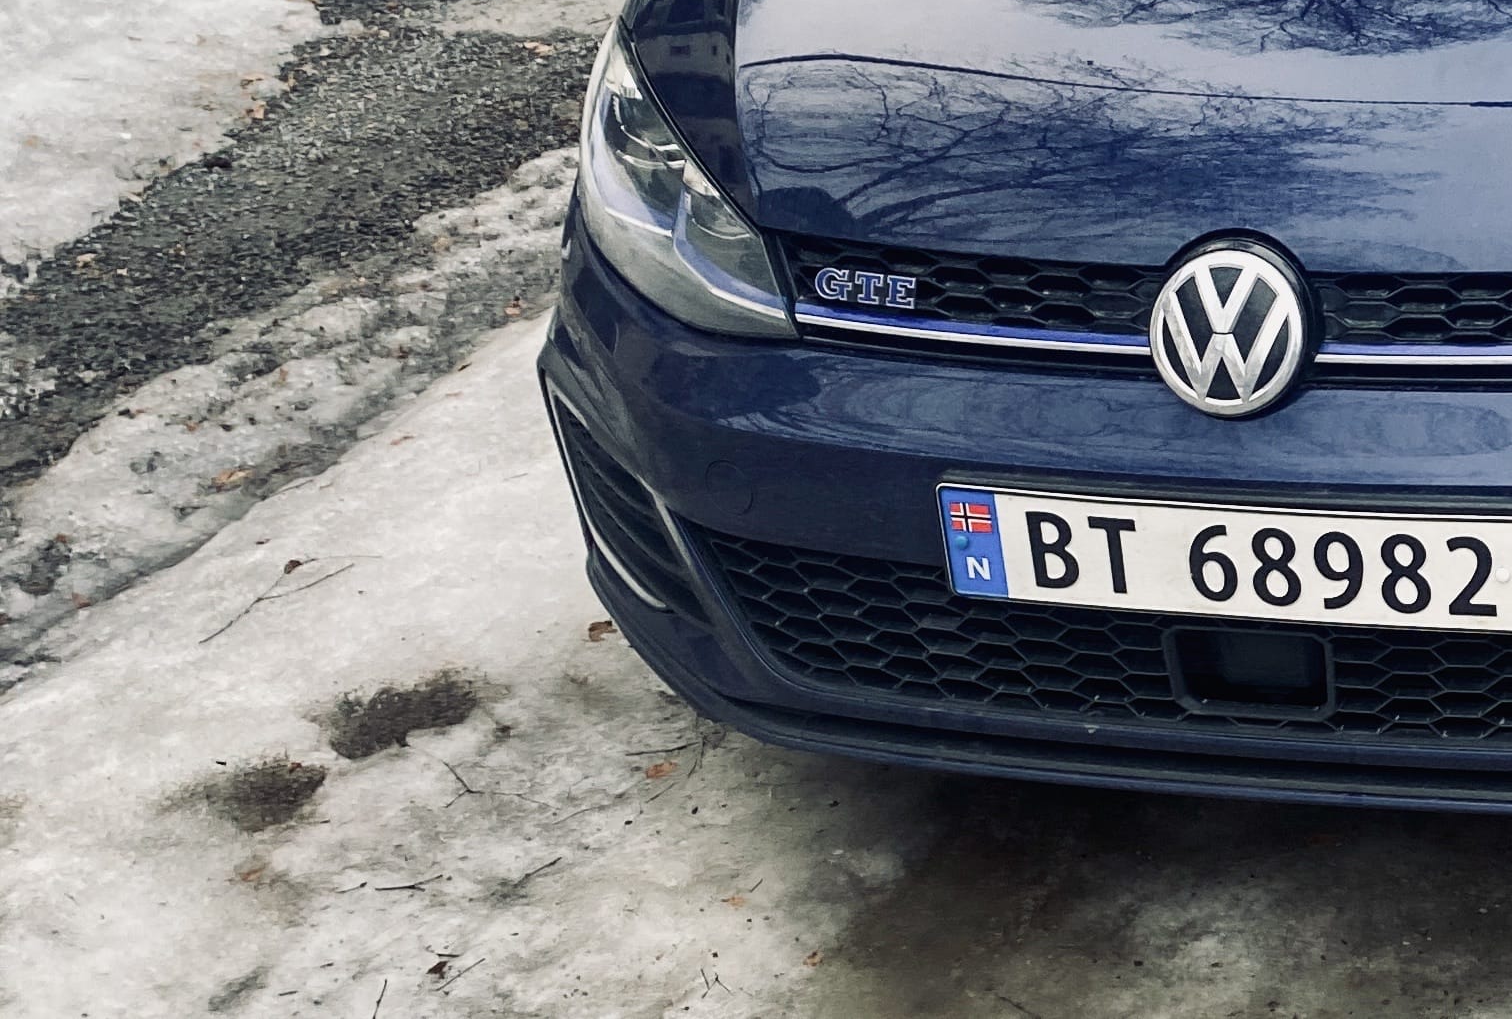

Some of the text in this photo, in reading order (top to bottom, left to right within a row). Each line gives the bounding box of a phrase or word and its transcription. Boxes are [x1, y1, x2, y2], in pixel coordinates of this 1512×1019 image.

[814, 267, 917, 309] GTE
[1149, 249, 1305, 417] VW
[966, 556, 990, 580] N
[1025, 510, 1498, 617] BT 68982
